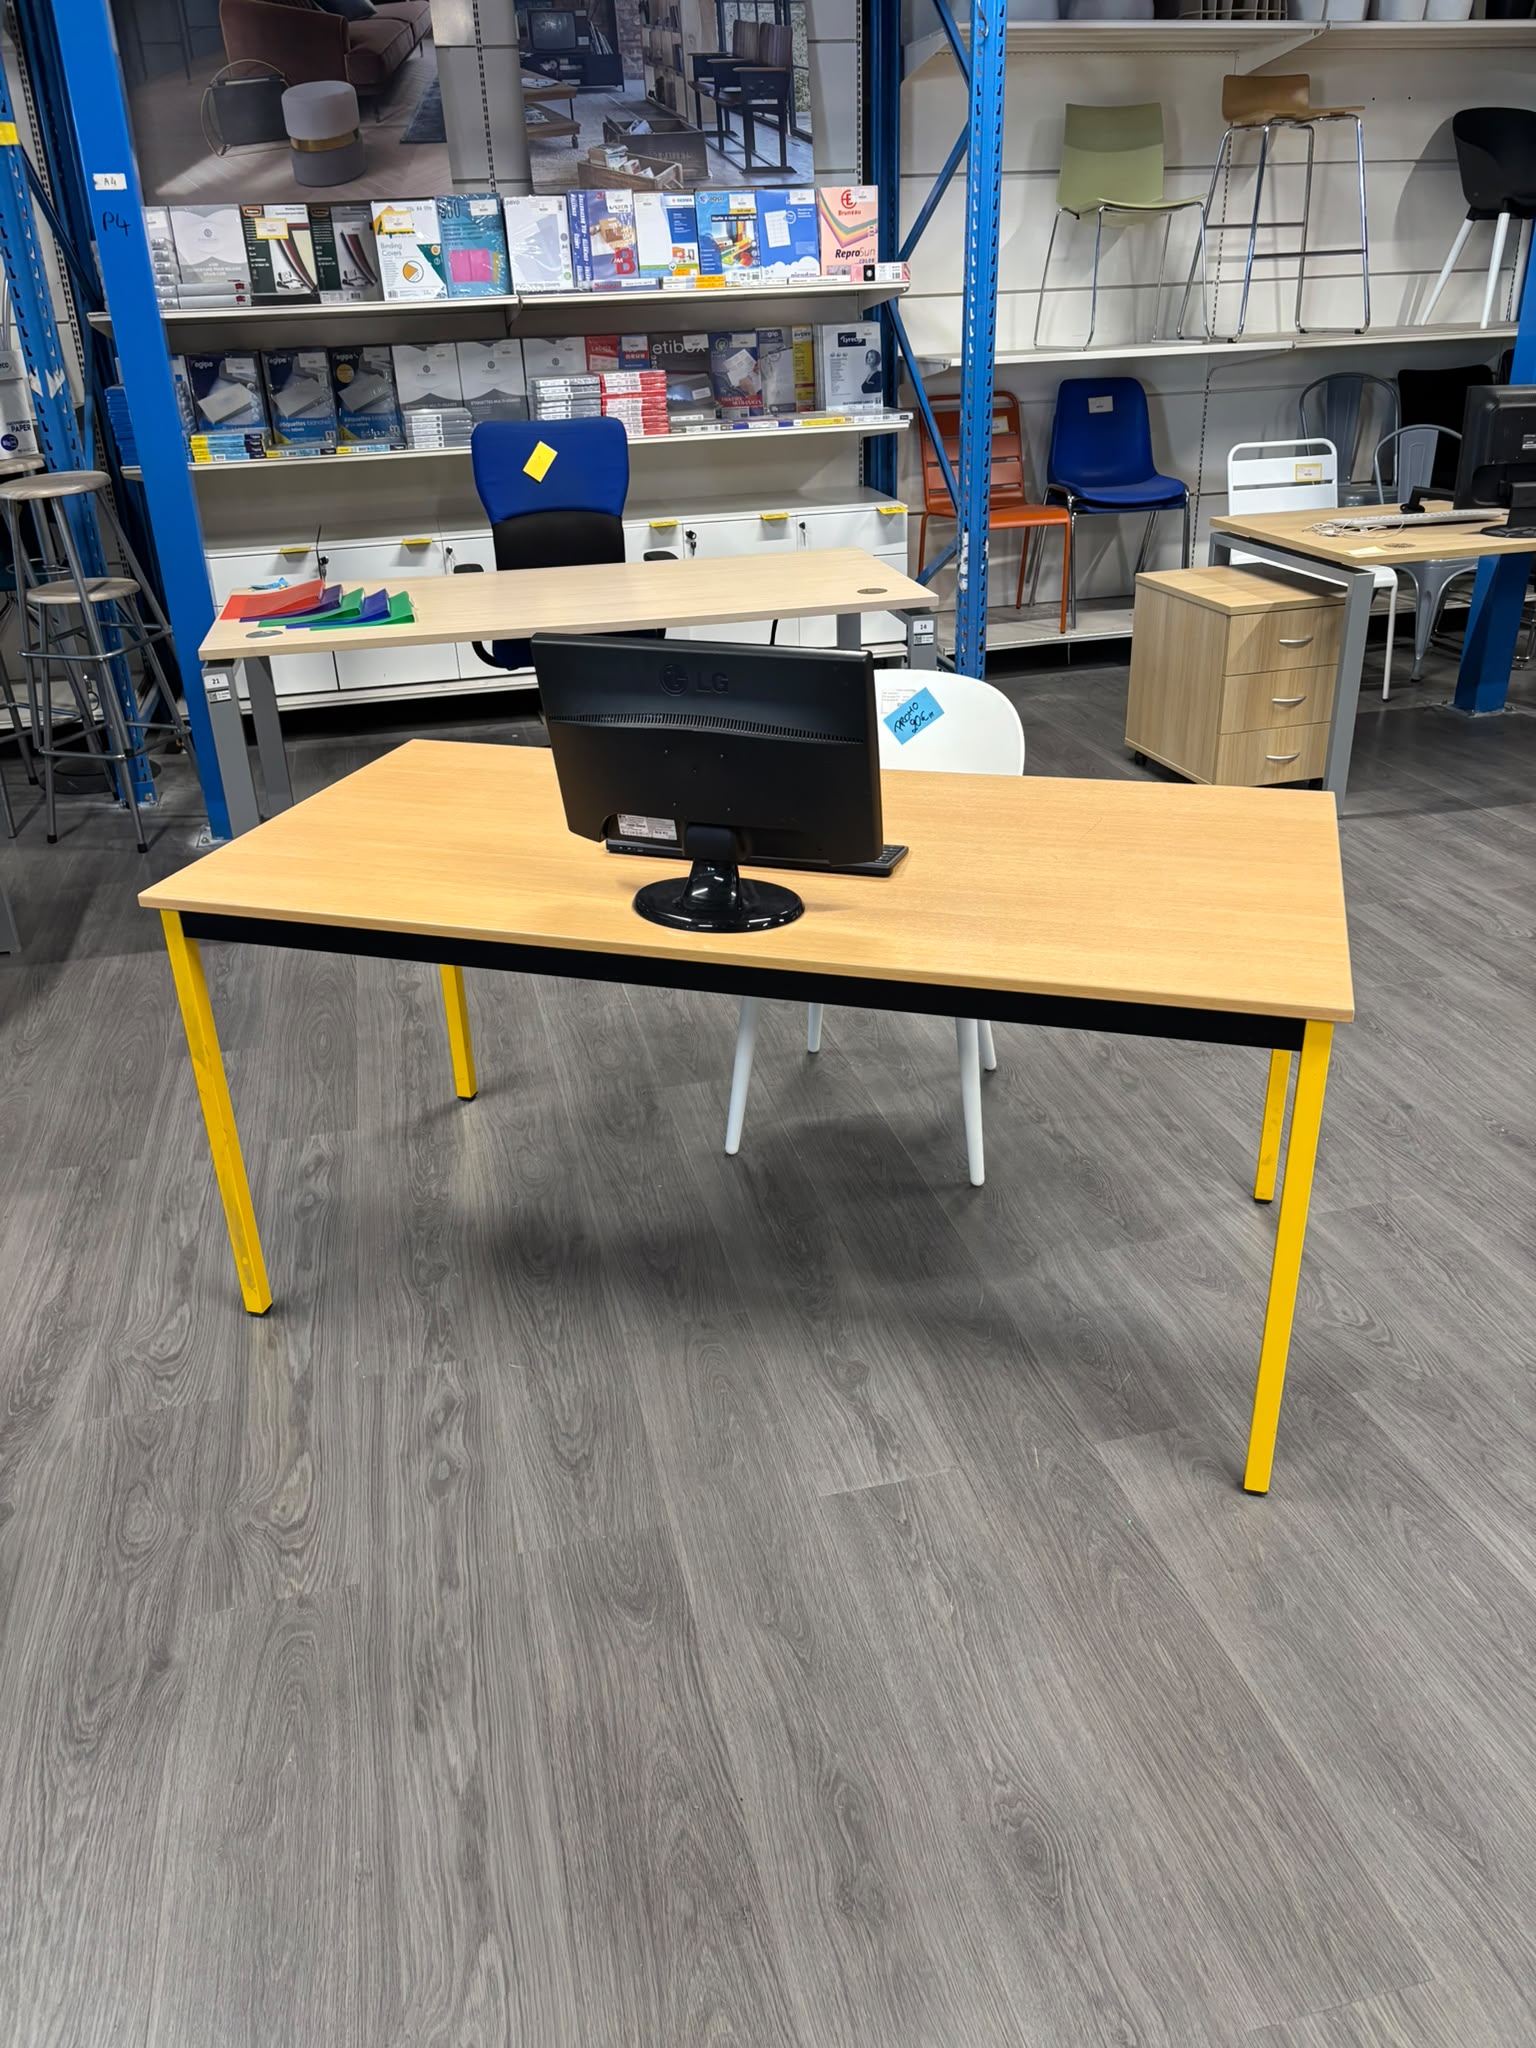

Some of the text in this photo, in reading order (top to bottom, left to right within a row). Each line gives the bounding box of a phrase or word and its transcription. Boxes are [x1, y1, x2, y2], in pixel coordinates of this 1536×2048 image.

[102, 211, 131, 236] P4
[381, 241, 402, 250] Binding
[381, 249, 402, 257] Covers
[835, 246, 876, 260] ReproSun
[194, 361, 213, 369] agipa
[10, 424, 32, 433] PAPER
[695, 671, 729, 694] LG
[894, 702, 919, 733] PROMO
